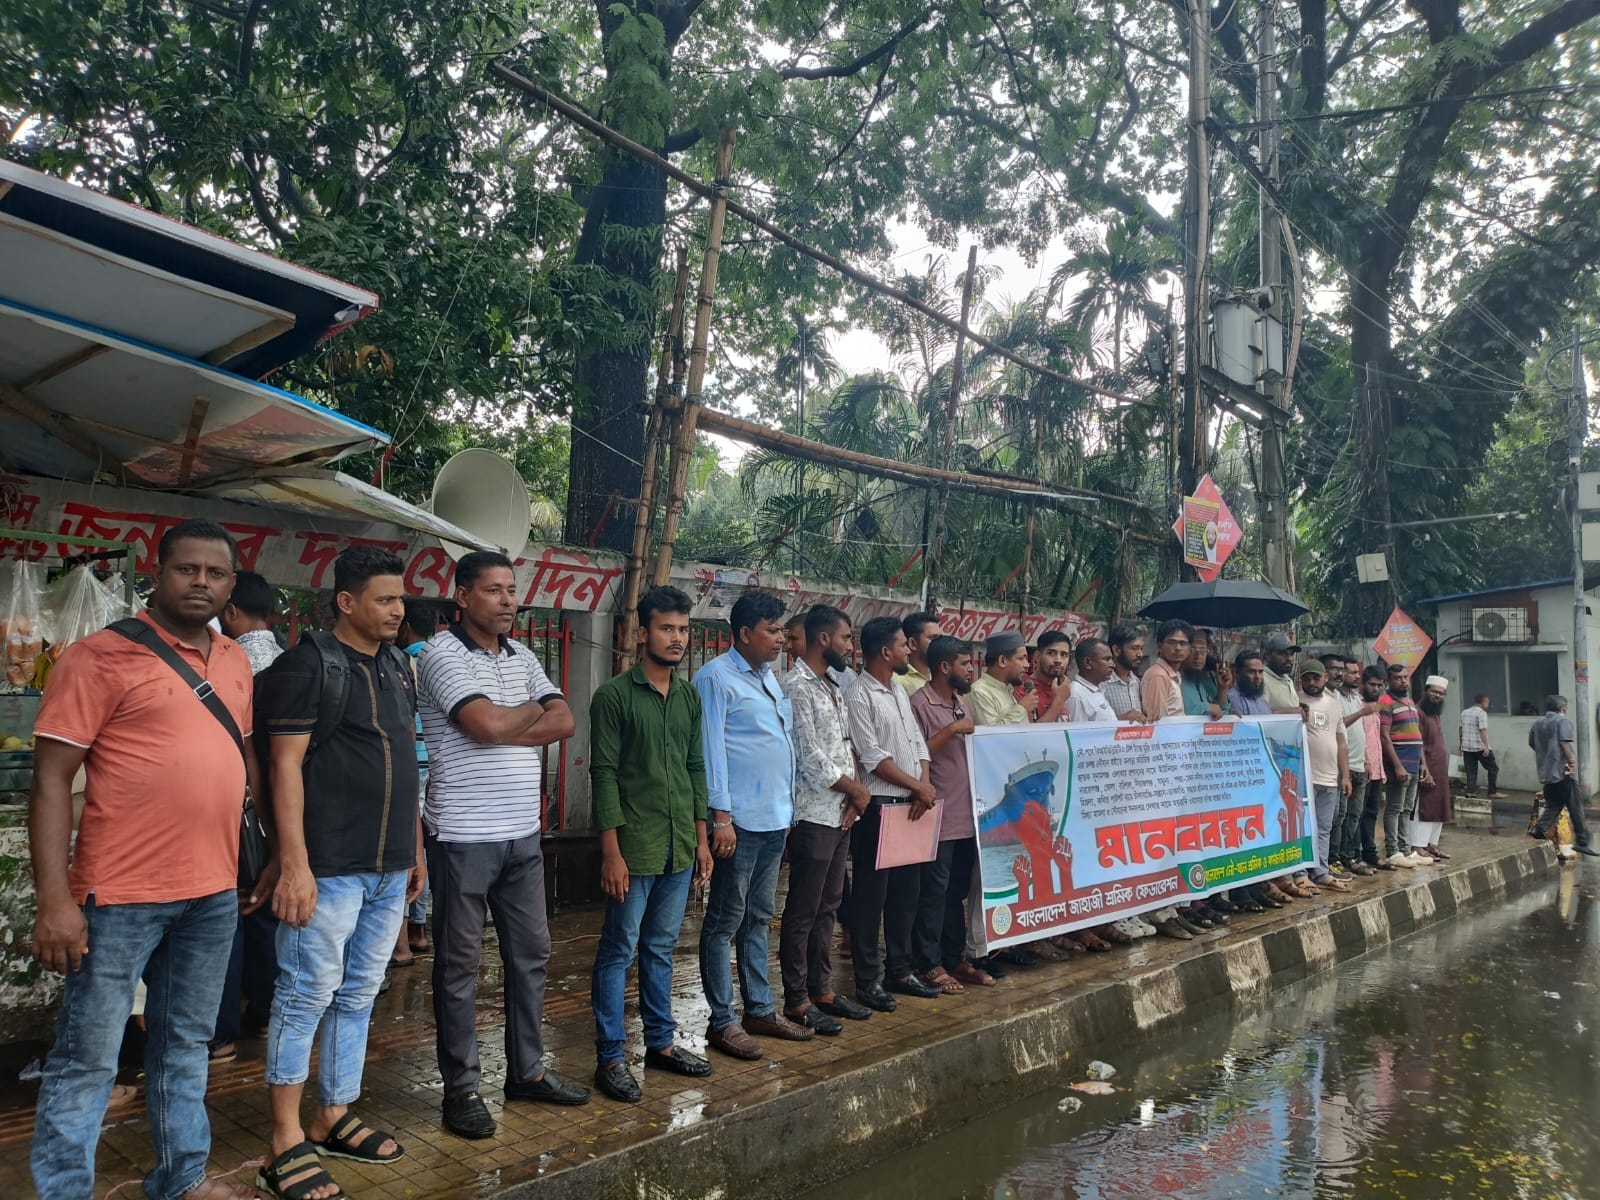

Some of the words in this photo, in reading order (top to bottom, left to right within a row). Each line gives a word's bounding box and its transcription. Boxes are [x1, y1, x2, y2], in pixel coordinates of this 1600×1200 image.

[523, 548, 622, 611] দিন
[1095, 804, 1266, 868] মানববন্ধন
[1016, 903, 1067, 927] বাংলাদেশ
[1069, 888, 1103, 914] জাহাজী
[1104, 884, 1133, 906] শ্রমিক
[1136, 876, 1178, 899] ফেডারেশন
